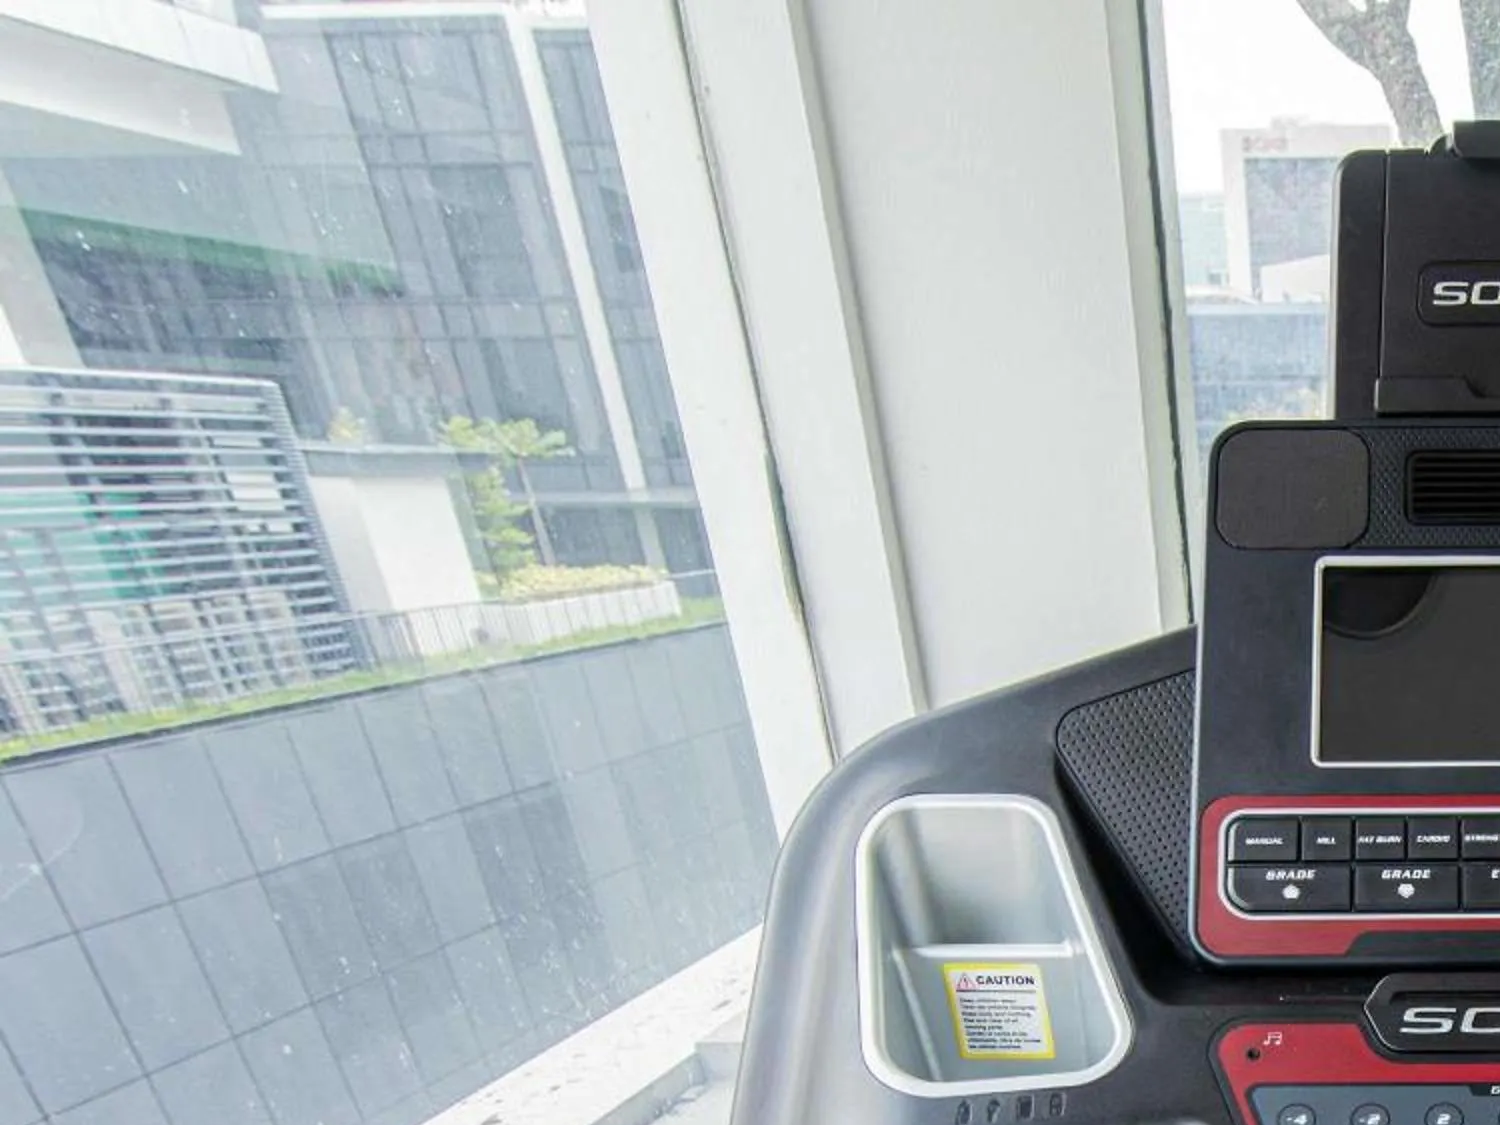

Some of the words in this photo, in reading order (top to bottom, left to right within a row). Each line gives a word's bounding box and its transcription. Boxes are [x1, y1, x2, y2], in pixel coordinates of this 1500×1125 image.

[1264, 867, 1317, 882] GRADE
[1380, 867, 1433, 881] GRADE
[975, 974, 1036, 986] CAUTION
[1285, 1113, 1308, 1125] -4
[1358, 1113, 1381, 1125] -2
[1436, 1113, 1451, 1125] 2
